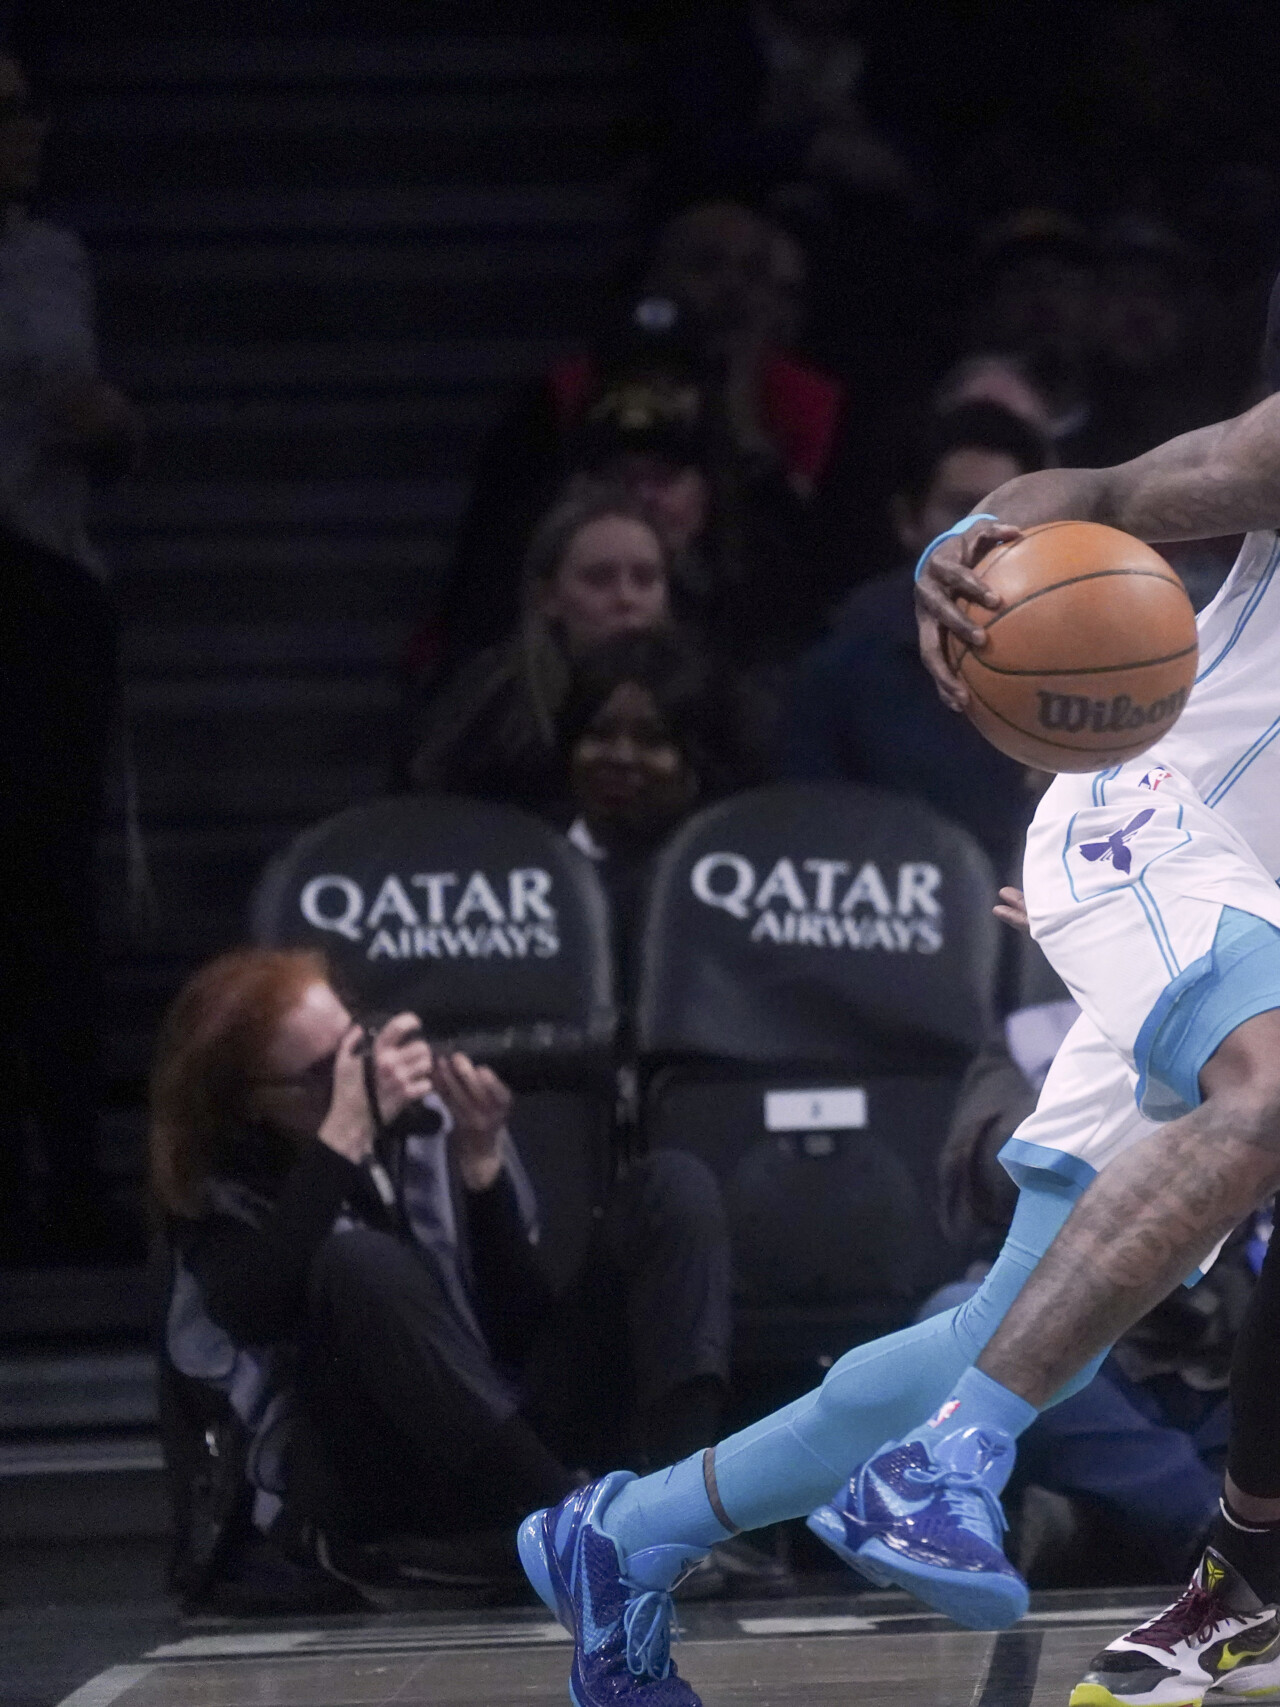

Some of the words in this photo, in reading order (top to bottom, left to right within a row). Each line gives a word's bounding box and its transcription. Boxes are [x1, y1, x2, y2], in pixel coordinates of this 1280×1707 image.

[1036, 685, 1188, 733] Wilson
[300, 867, 556, 941] QATAR
[690, 851, 942, 919] QATAR
[365, 922, 560, 961] AIRWAYS
[749, 909, 944, 954] AIRWAYS
